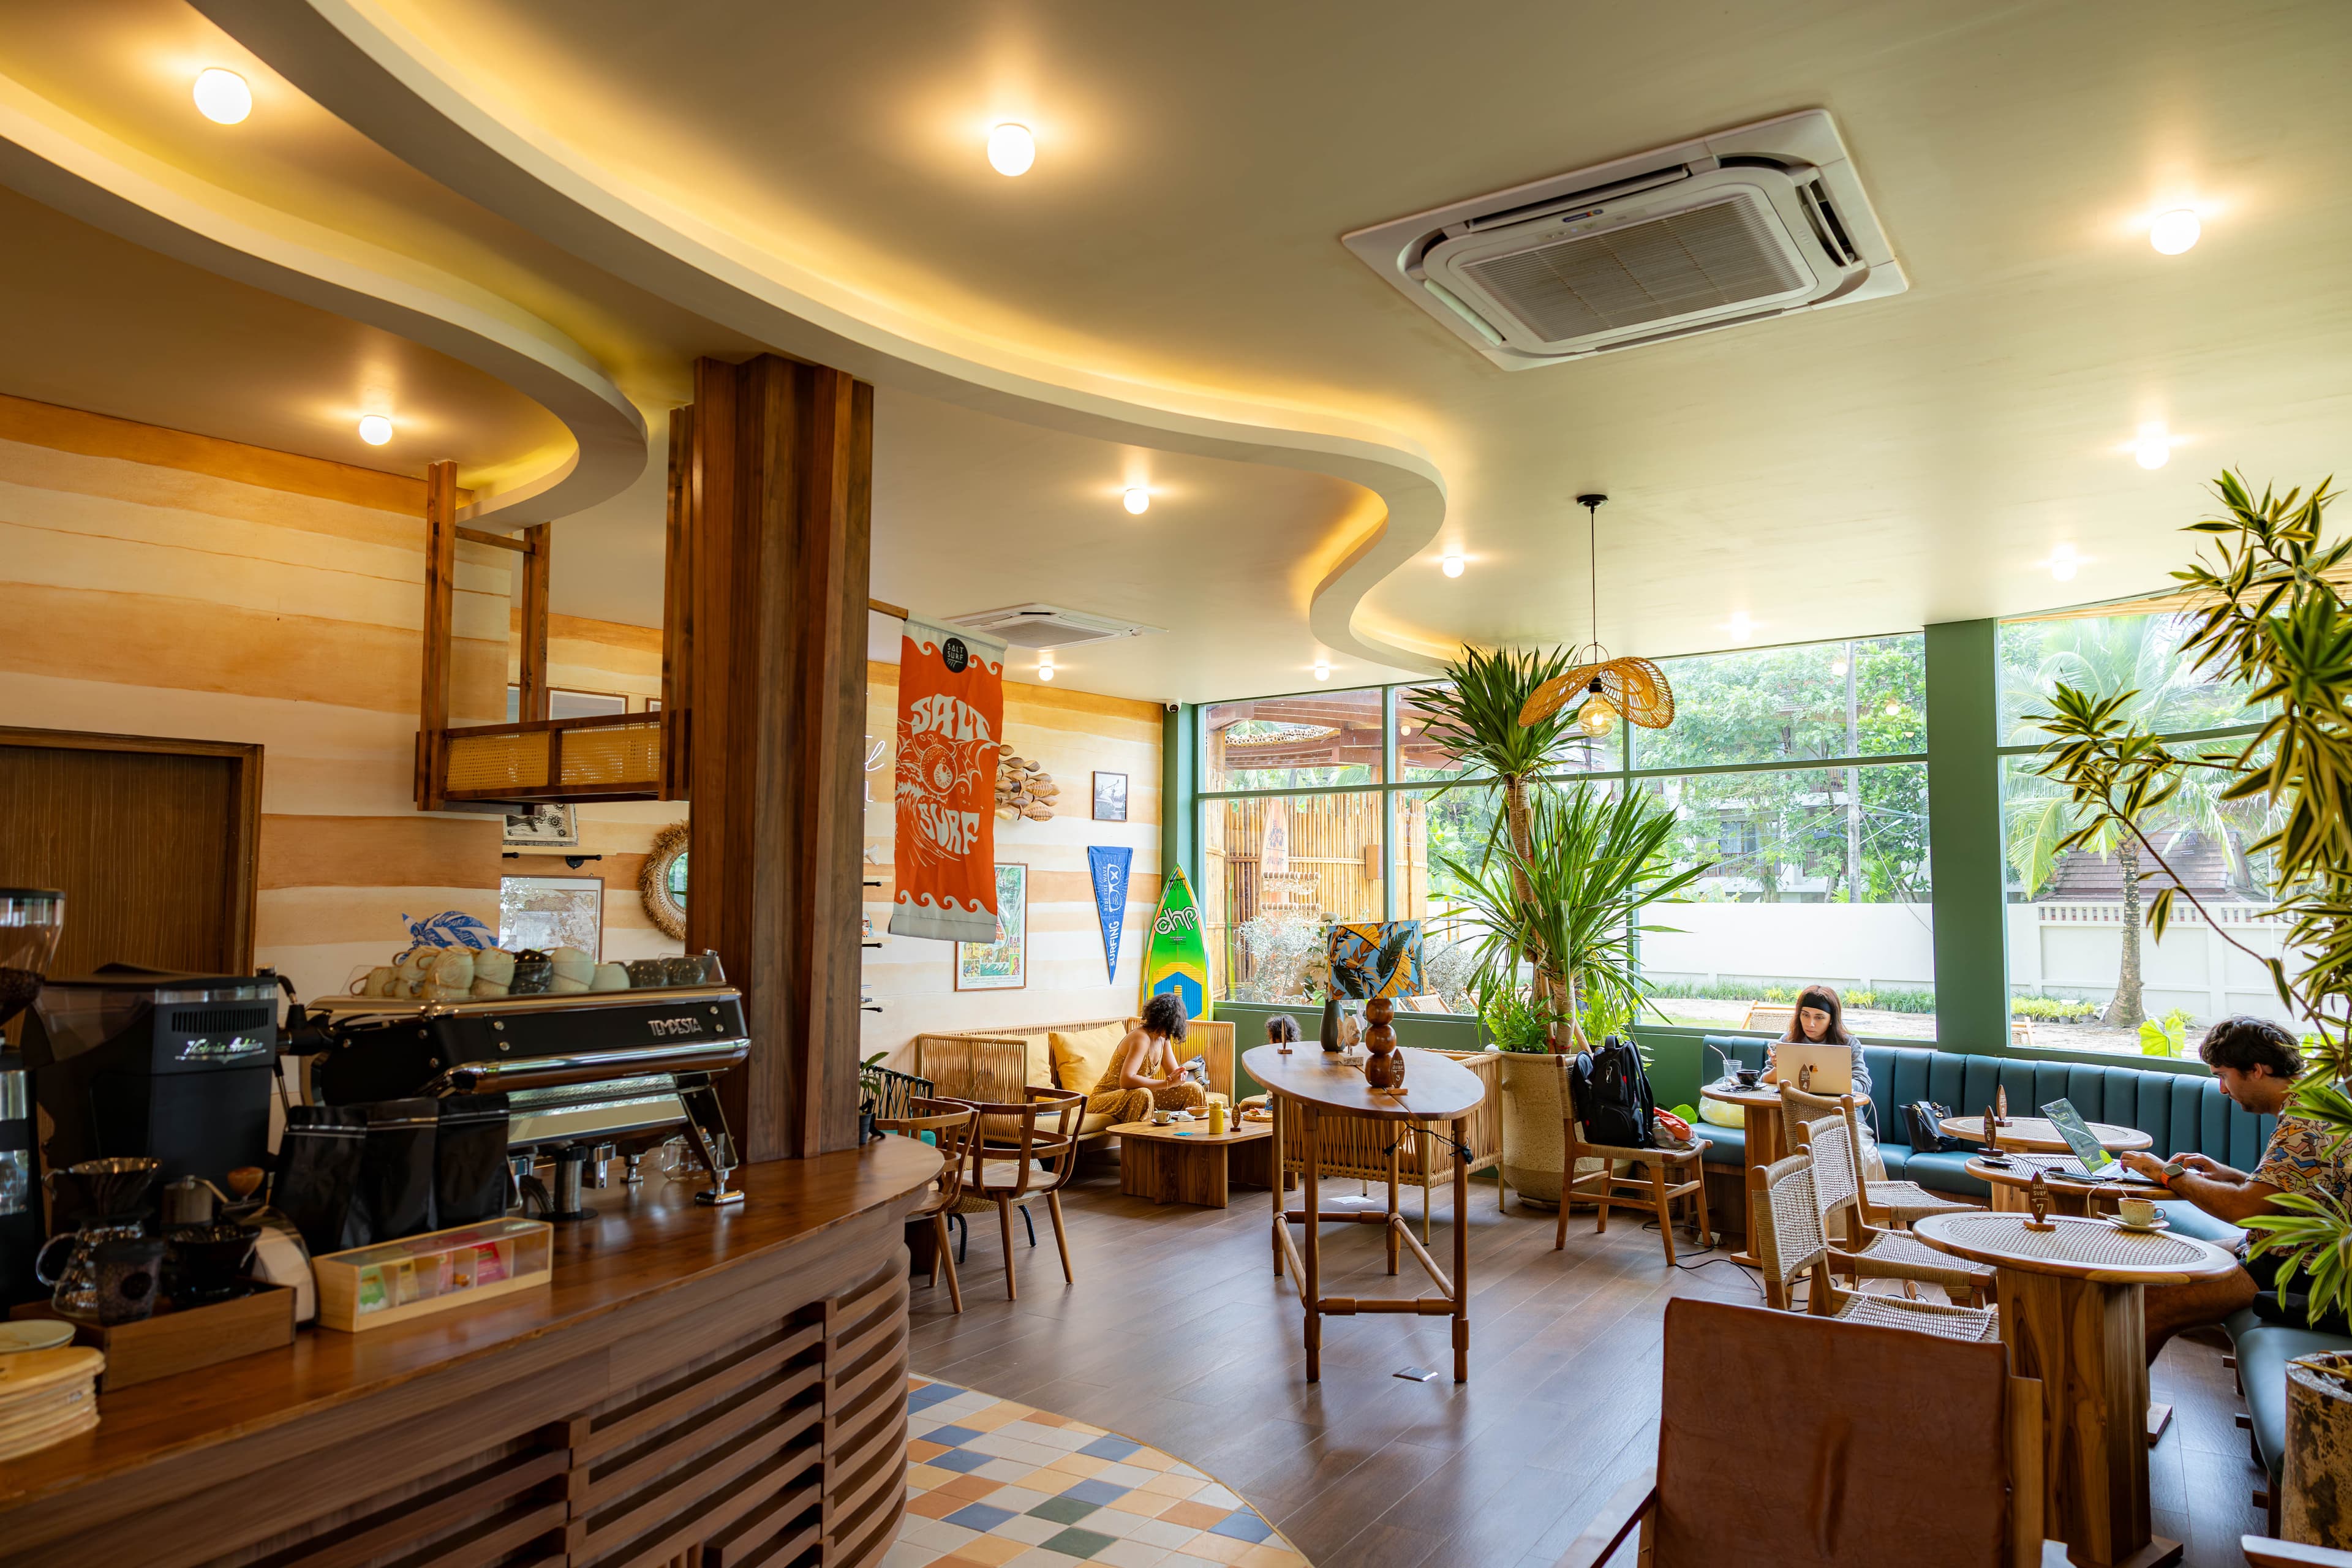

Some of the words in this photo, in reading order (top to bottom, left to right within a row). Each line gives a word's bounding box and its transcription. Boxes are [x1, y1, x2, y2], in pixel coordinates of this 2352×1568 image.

[947, 643, 964, 654] SALT
[947, 650, 963, 661] SURF
[910, 693, 990, 741] SALT
[918, 803, 980, 855] SURF
[1109, 921, 1119, 966] SURFING
[647, 1017, 703, 1036] TEMPESTA
[2037, 1204, 2044, 1214] 7
